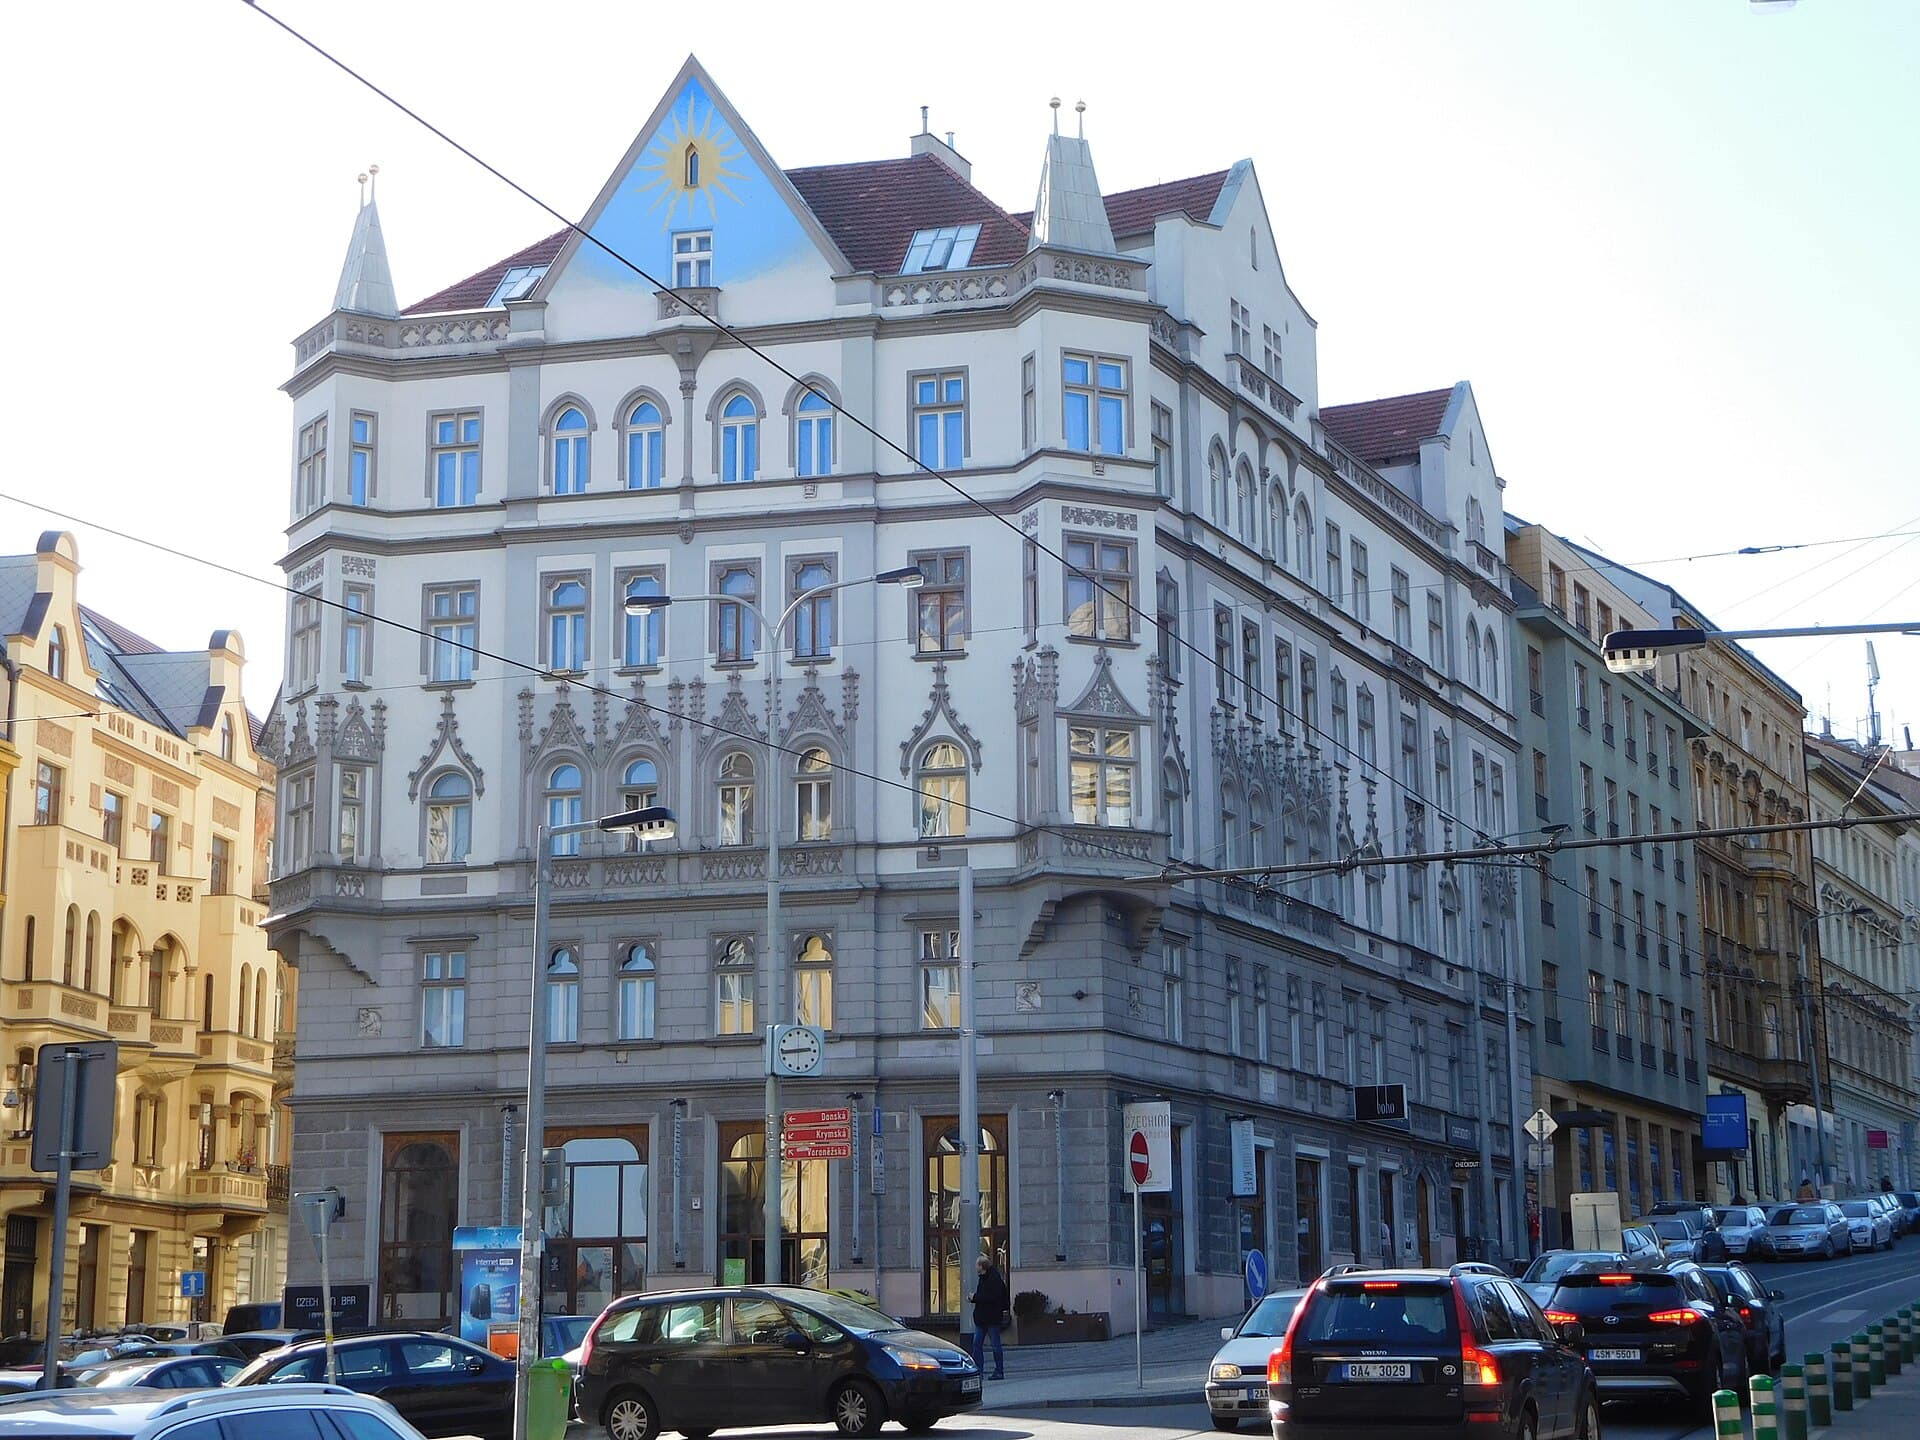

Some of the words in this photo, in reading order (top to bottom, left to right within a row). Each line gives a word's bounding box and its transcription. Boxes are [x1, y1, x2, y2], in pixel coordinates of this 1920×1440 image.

[821, 1111, 846, 1121] Donská
[504, 1116, 512, 1143] BAR
[816, 1128, 846, 1140] Krymská
[475, 1258, 498, 1266] Internet
[1350, 1365, 1370, 1377] 8A4
[1379, 1365, 1406, 1377] 3029
